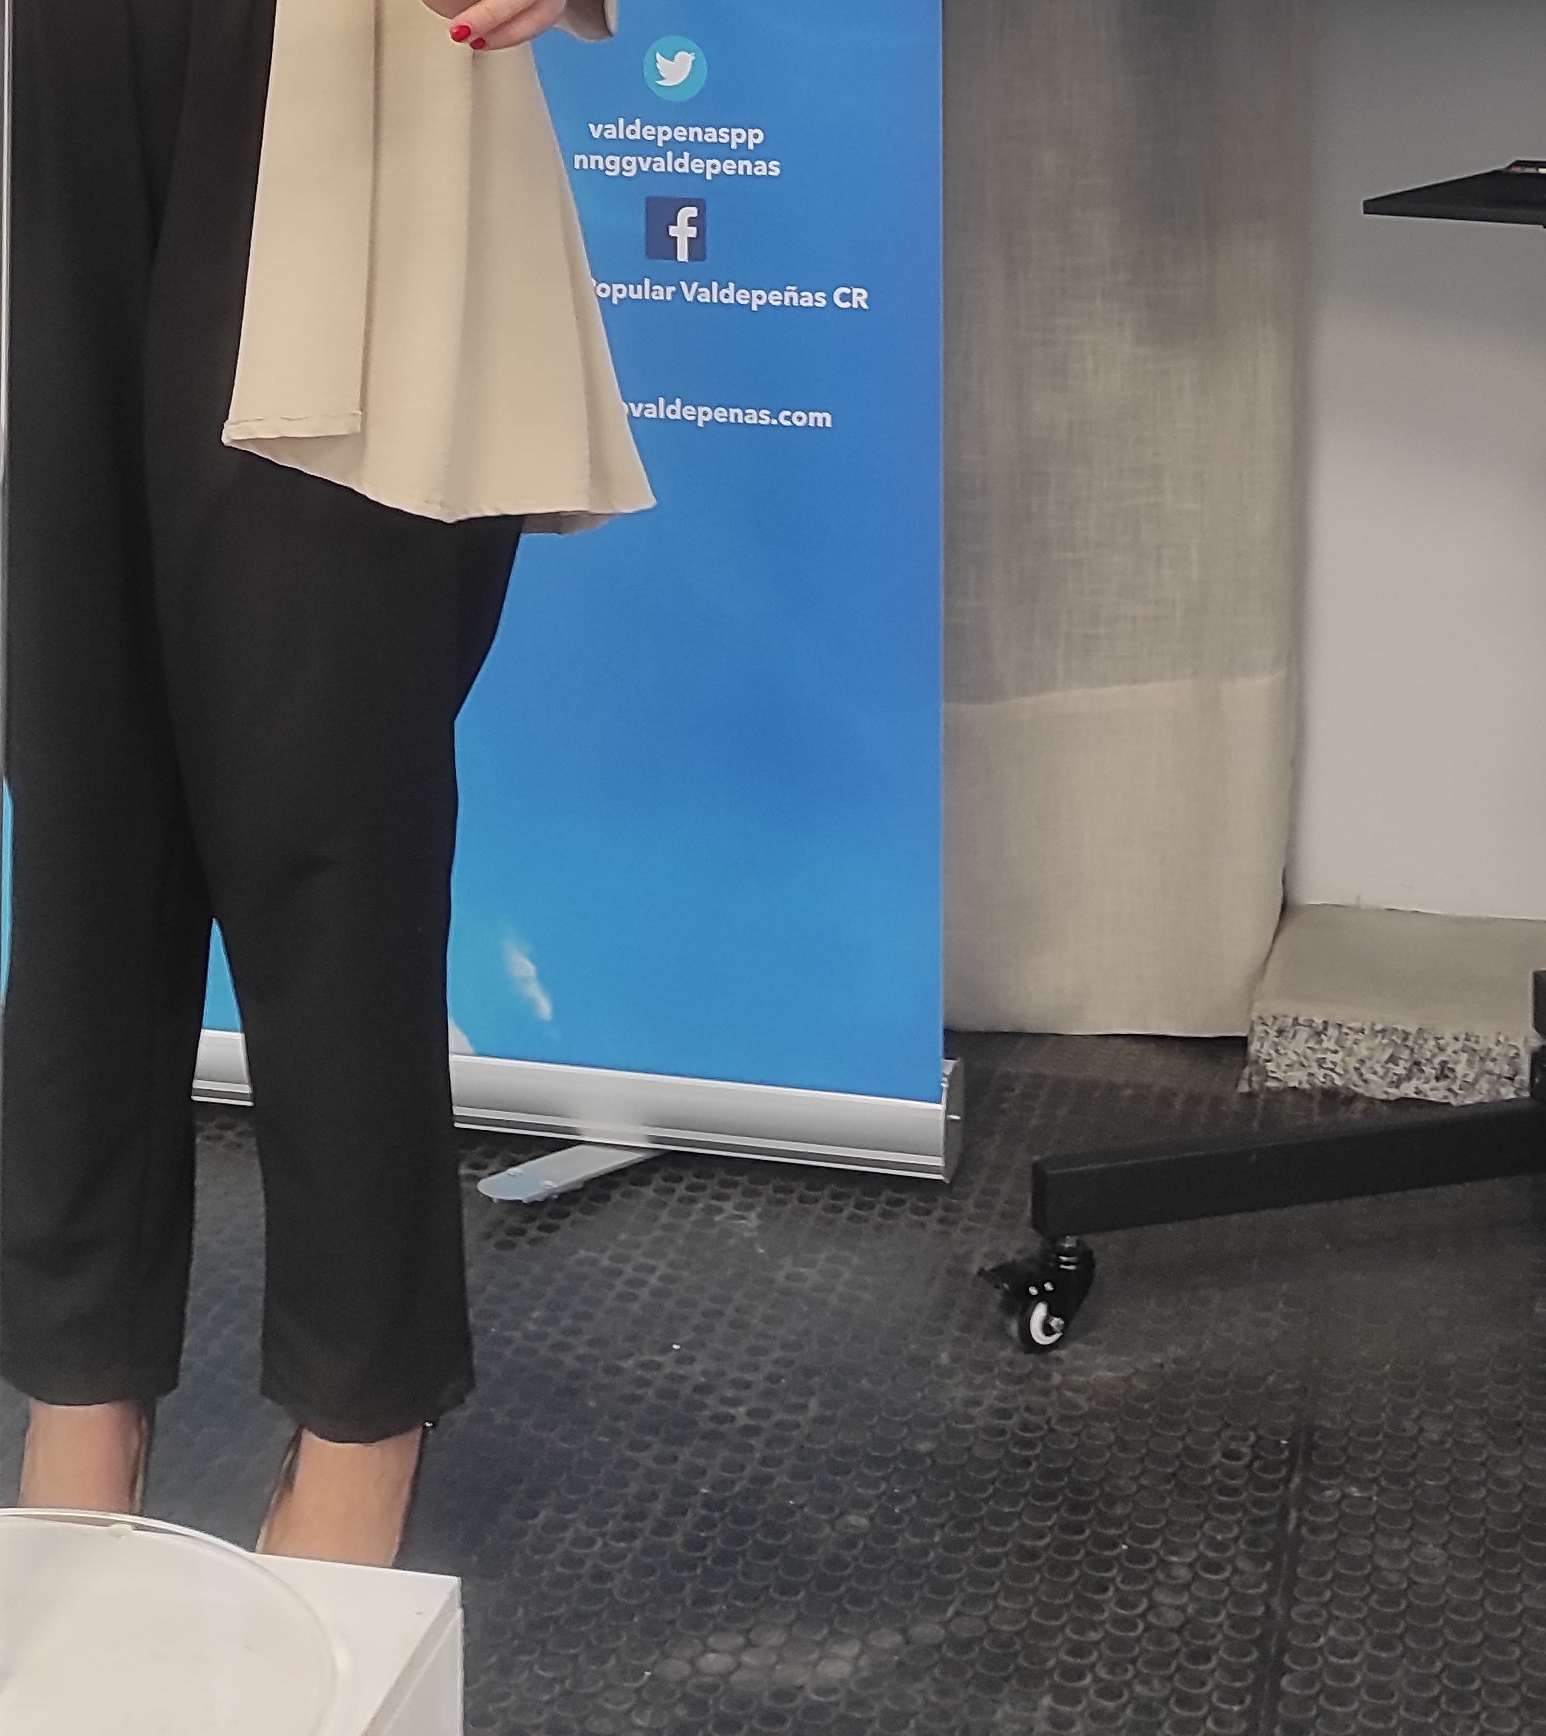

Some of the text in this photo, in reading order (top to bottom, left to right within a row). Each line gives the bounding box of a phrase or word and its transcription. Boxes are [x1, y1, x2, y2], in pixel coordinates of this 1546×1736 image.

[587, 117, 765, 150] valdepenaspp
[573, 150, 782, 180] nnggvaldepenas
[591, 277, 870, 311] opular Valdepeñas CR
